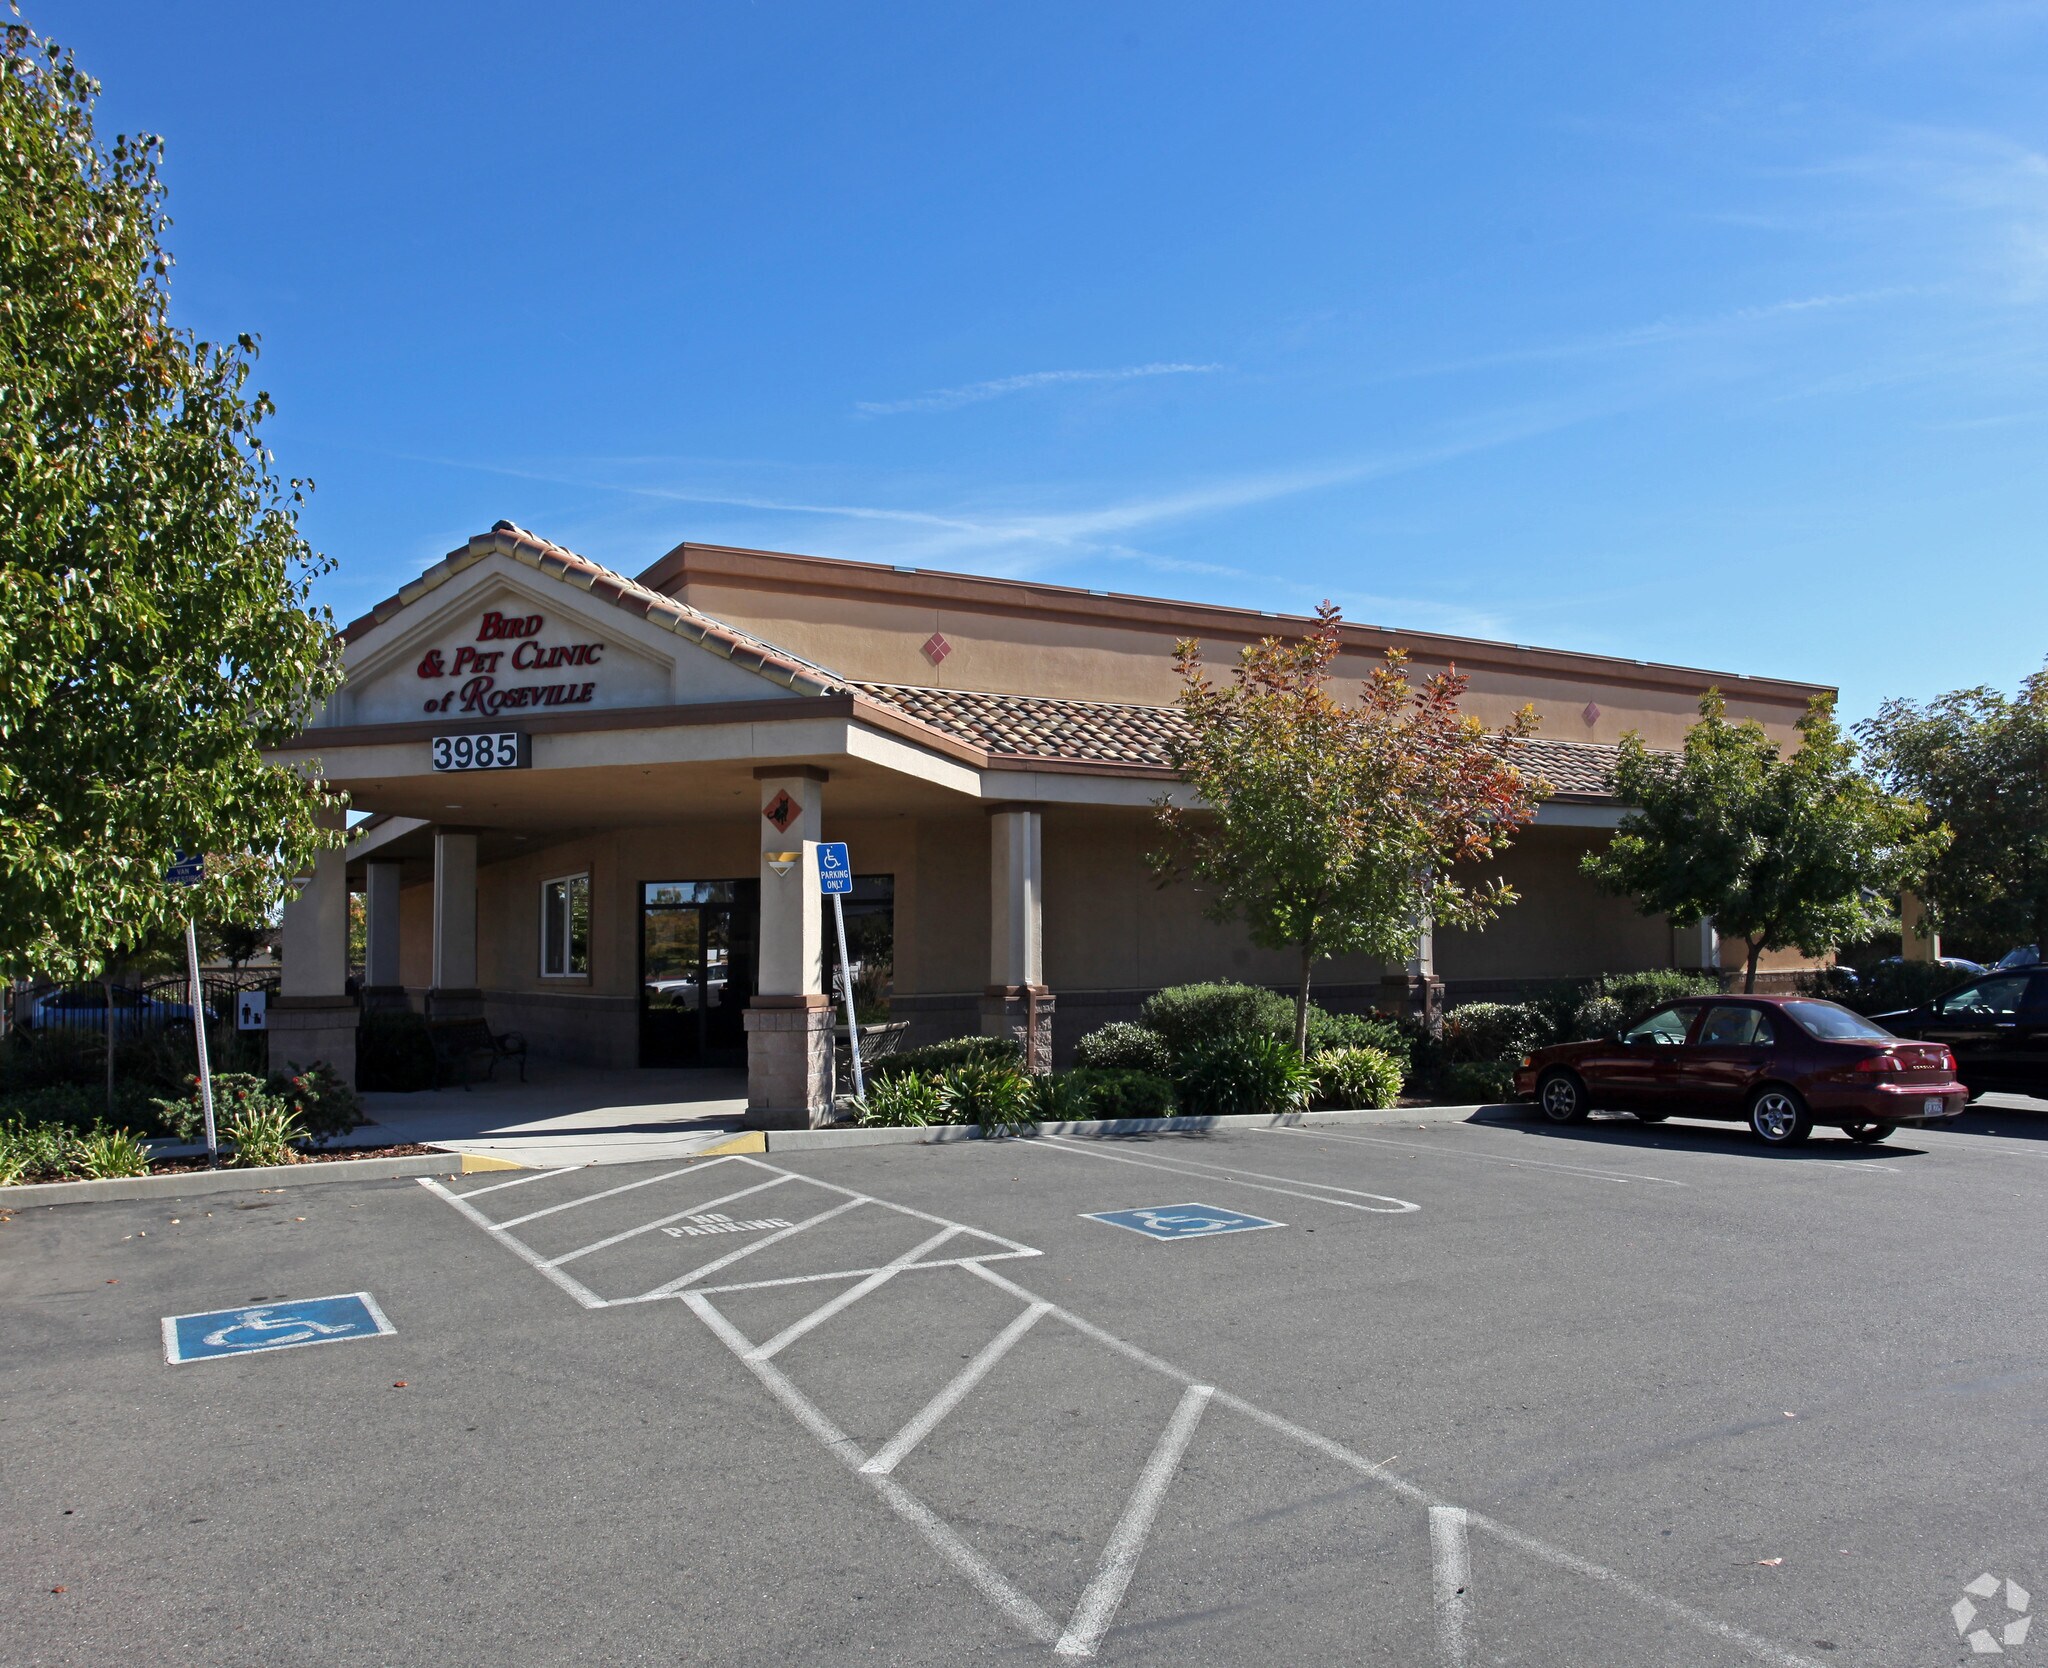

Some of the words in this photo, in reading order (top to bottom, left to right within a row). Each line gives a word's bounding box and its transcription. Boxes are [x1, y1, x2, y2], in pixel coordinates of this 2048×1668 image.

[417, 649, 445, 678] &
[449, 646, 503, 676] PET
[511, 641, 604, 670] CLINIC
[423, 691, 454, 713] of
[459, 675, 595, 717] ROSEVILLE
[433, 734, 516, 770] 3985
[820, 870, 849, 880] PARKING
[826, 880, 844, 889] ONLY
[660, 1218, 795, 1238] PARKING
[686, 1213, 734, 1225] NO
